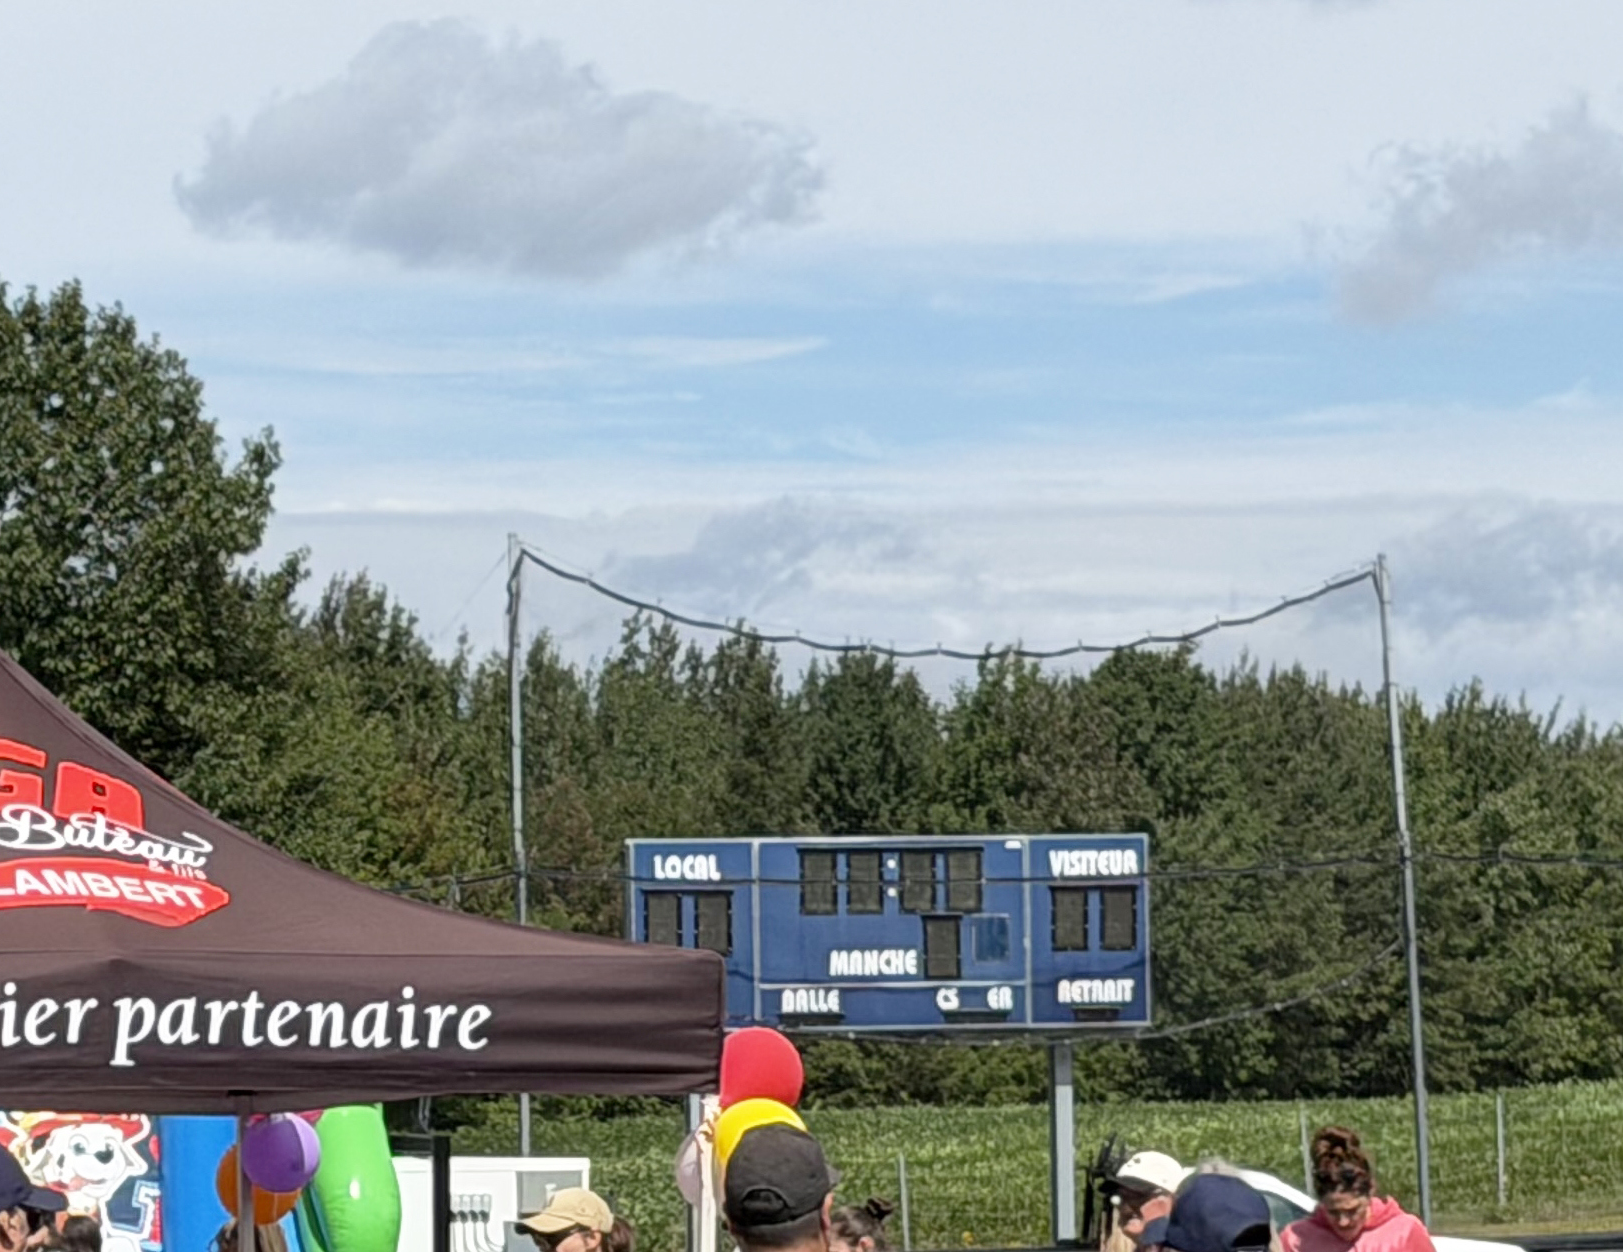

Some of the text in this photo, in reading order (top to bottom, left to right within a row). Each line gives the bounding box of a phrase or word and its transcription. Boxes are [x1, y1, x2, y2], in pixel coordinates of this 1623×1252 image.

[654, 854, 721, 881] LOCAL
[1048, 849, 1139, 877] VISITEUR
[829, 949, 918, 976] MANCHE
[781, 988, 840, 1013] BALLE
[987, 986, 1014, 1011] ER
[1057, 978, 1135, 1004] RETRAIT
[109, 986, 493, 1067] partenaire
